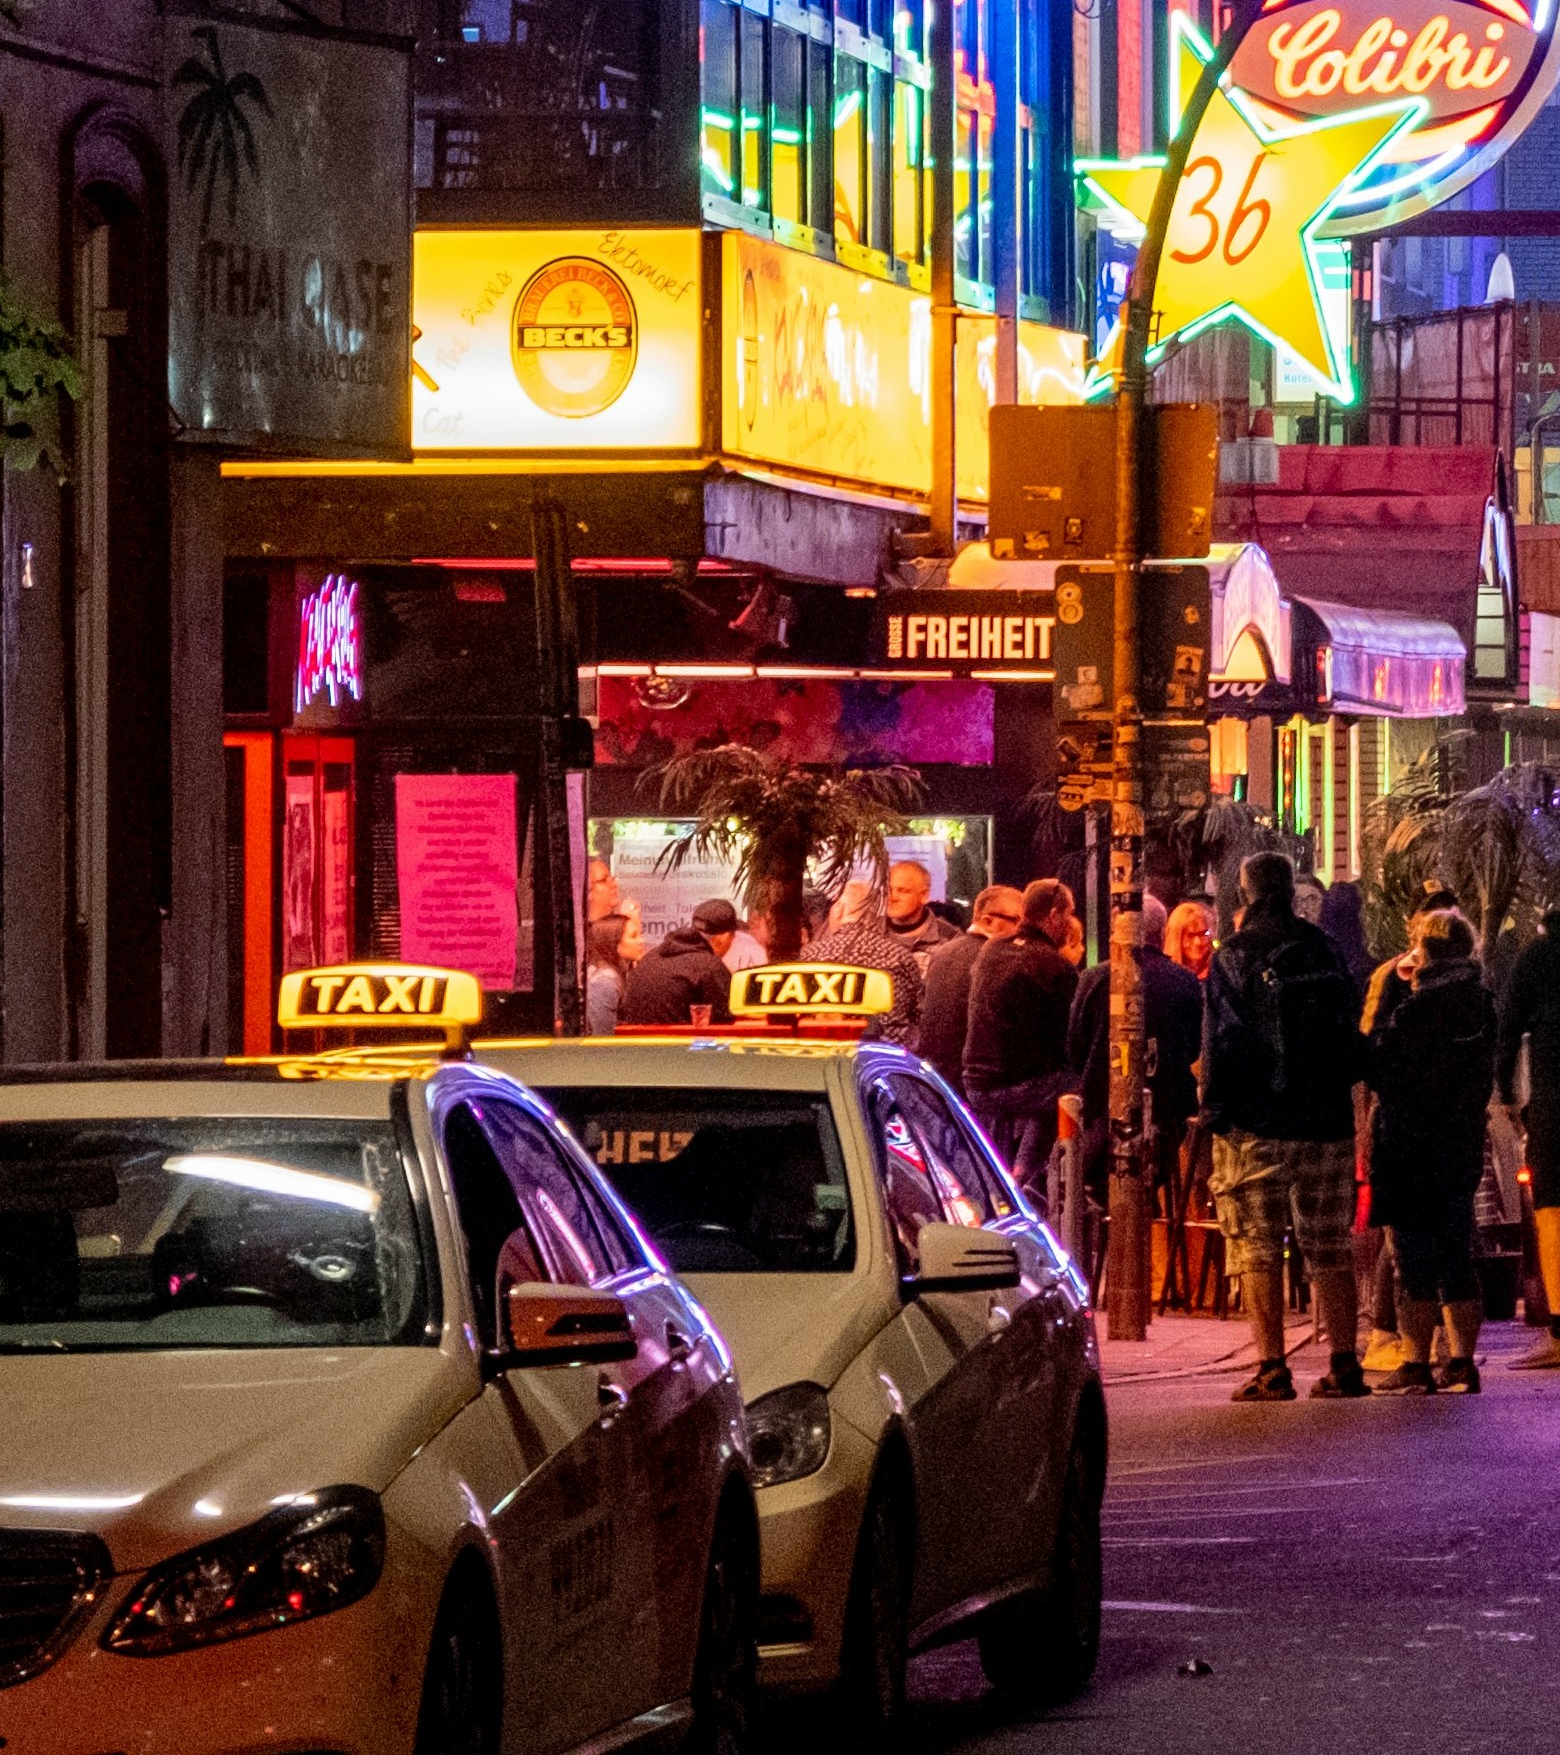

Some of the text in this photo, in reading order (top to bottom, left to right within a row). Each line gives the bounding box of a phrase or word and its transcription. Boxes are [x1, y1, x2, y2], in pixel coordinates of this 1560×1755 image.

[1268, 9, 1510, 98] Colibri
[1170, 153, 1271, 266] 36
[522, 326, 628, 348] BECK'S
[906, 616, 1057, 659] FREIHEIT
[310, 975, 436, 1013] TAXI
[753, 971, 856, 1005] TAXI
